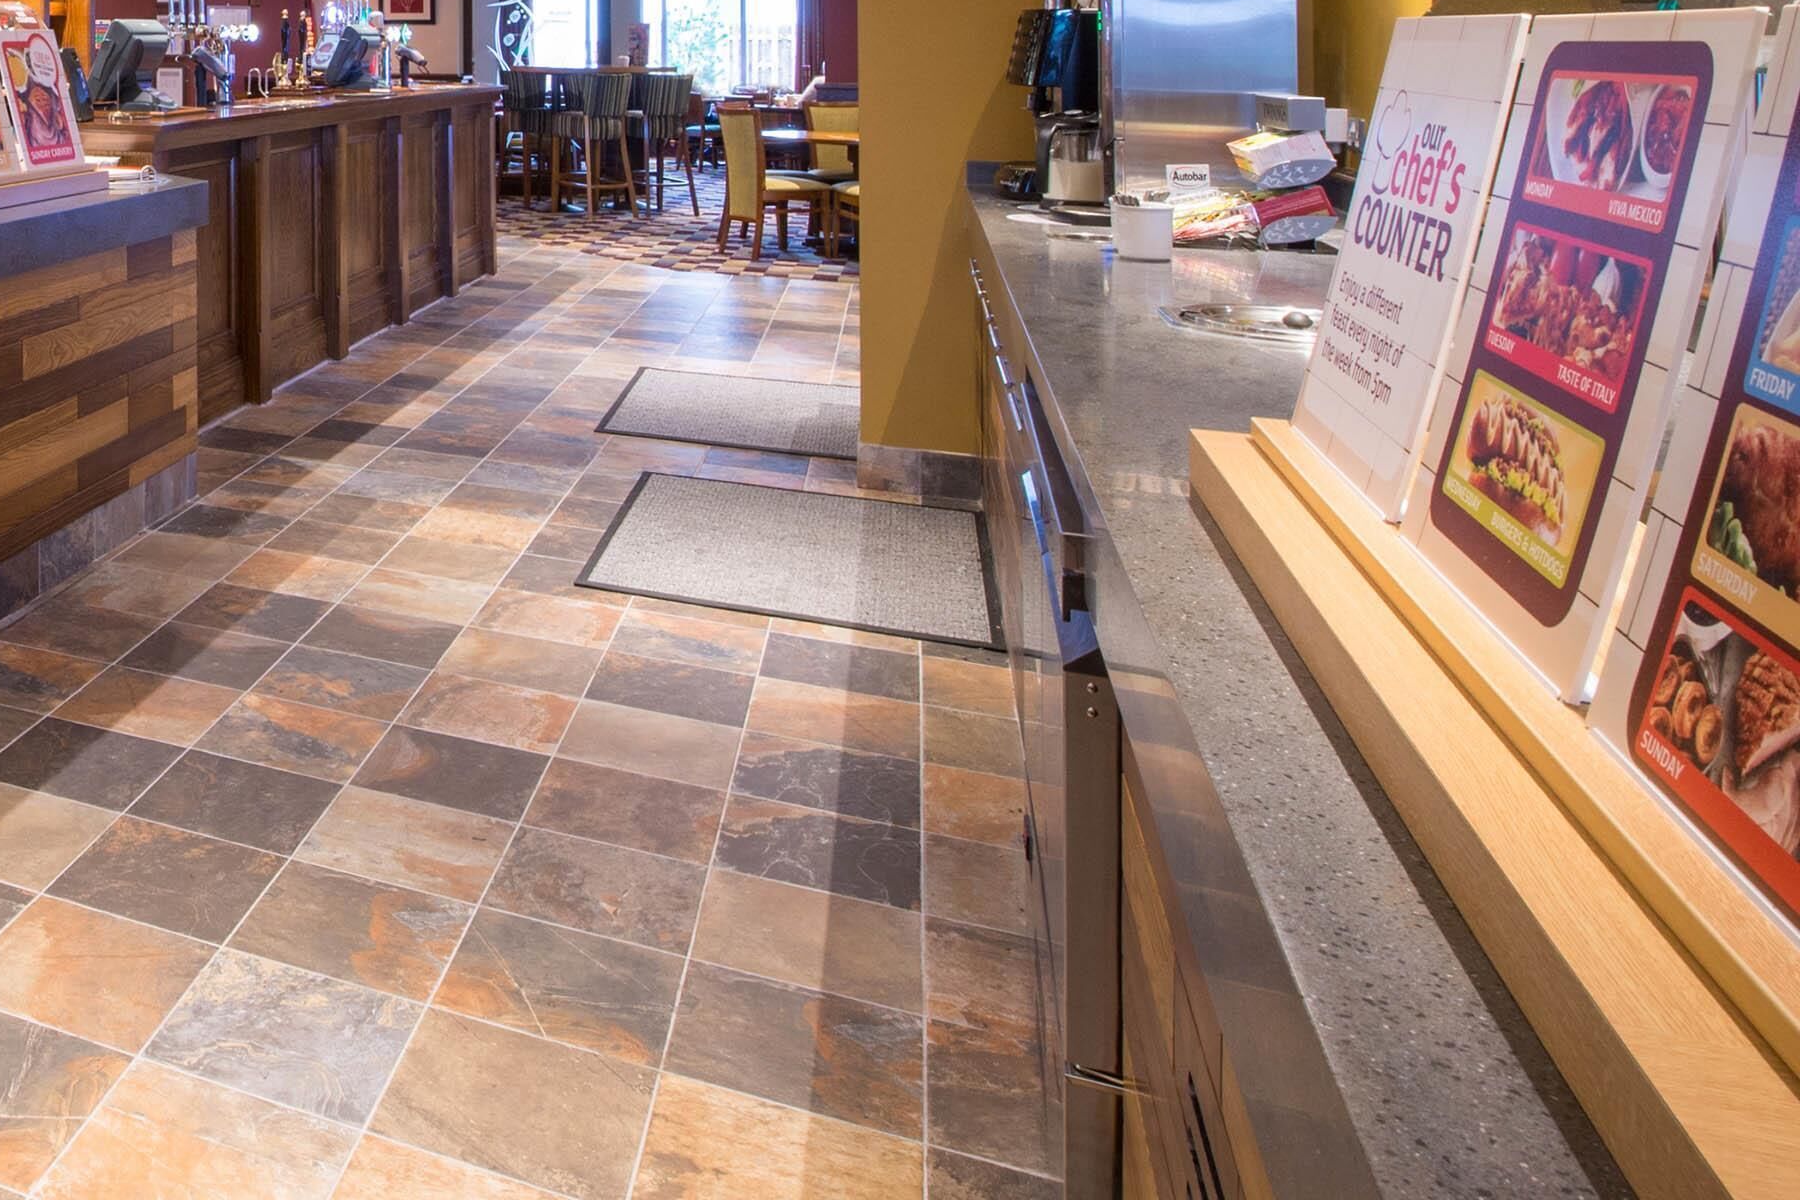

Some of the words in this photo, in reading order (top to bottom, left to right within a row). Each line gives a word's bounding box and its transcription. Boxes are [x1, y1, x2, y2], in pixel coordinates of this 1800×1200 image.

[1422, 123, 1447, 150] our
[1173, 168, 1207, 181] Autobar
[1391, 134, 1466, 214] chef's
[1525, 181, 1554, 200] MONDAY
[1608, 199, 1627, 217] VIVA
[1628, 204, 1663, 226] MEXICO
[1354, 194, 1452, 282] COUNTER
[1340, 271, 1360, 306] Enjoy
[1360, 286, 1366, 304] a
[1366, 284, 1404, 325] different
[1330, 303, 1351, 334] feast
[1348, 320, 1370, 353] every
[1368, 331, 1393, 362] night
[1392, 344, 1406, 368] of
[1321, 336, 1335, 362] the
[1333, 351, 1354, 376] week
[1352, 356, 1372, 390] from
[1370, 371, 1392, 405] 5pm
[1487, 330, 1516, 354] TUESDAY
[1557, 364, 1581, 388] TASTE
[1580, 376, 1592, 392] OF
[1591, 383, 1616, 405] ITALY
[1749, 368, 1796, 400] FRIDAY
[1491, 511, 1523, 546] BURGERS
[1521, 536, 1530, 552] &
[1528, 541, 1565, 580] HOTDOGS
[1697, 552, 1758, 605] SATURDAY
[1639, 730, 1686, 782] SUNDAY
